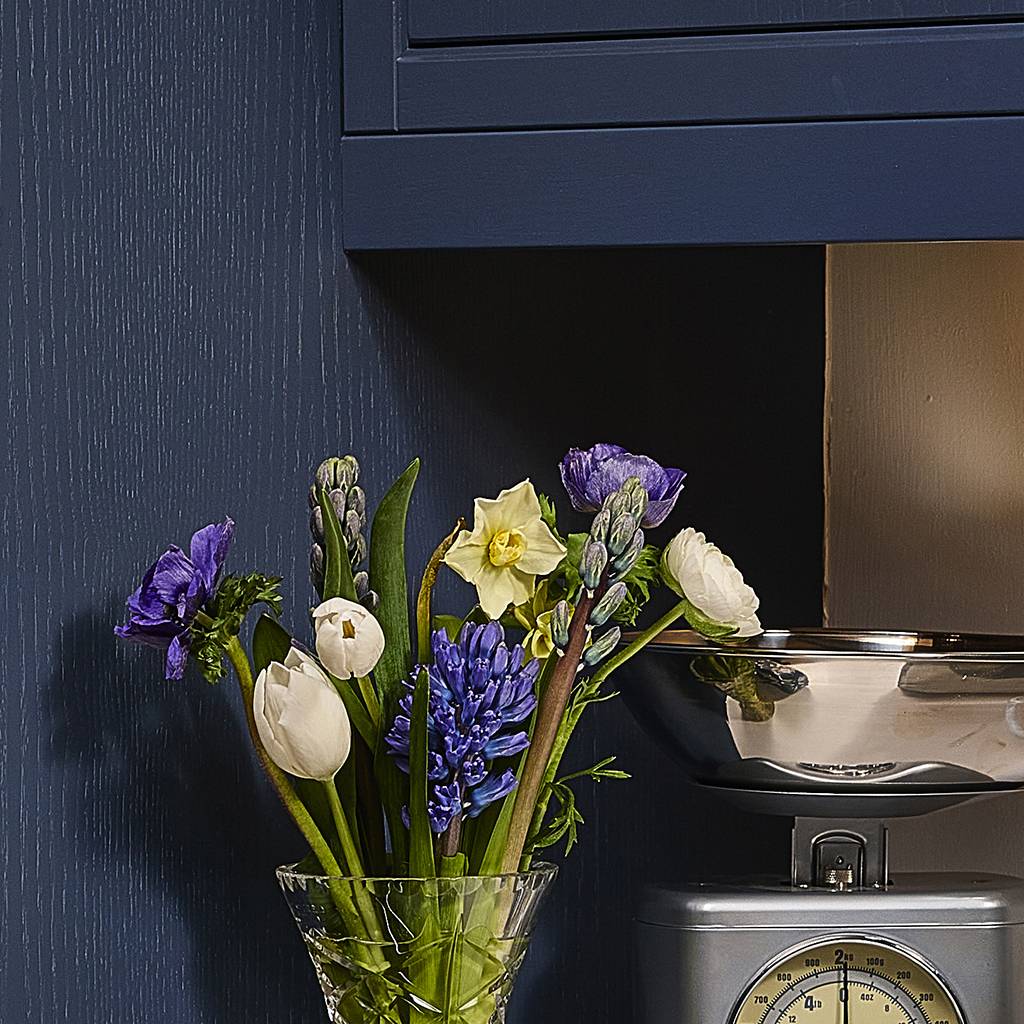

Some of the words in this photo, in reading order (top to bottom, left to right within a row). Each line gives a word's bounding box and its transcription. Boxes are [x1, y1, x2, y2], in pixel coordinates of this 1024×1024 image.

[896, 972, 910, 980] 200
[754, 996, 769, 1004] 700
[919, 993, 934, 1001] 300
[884, 1004, 890, 1012] 8
[788, 1015, 797, 1024] 12
